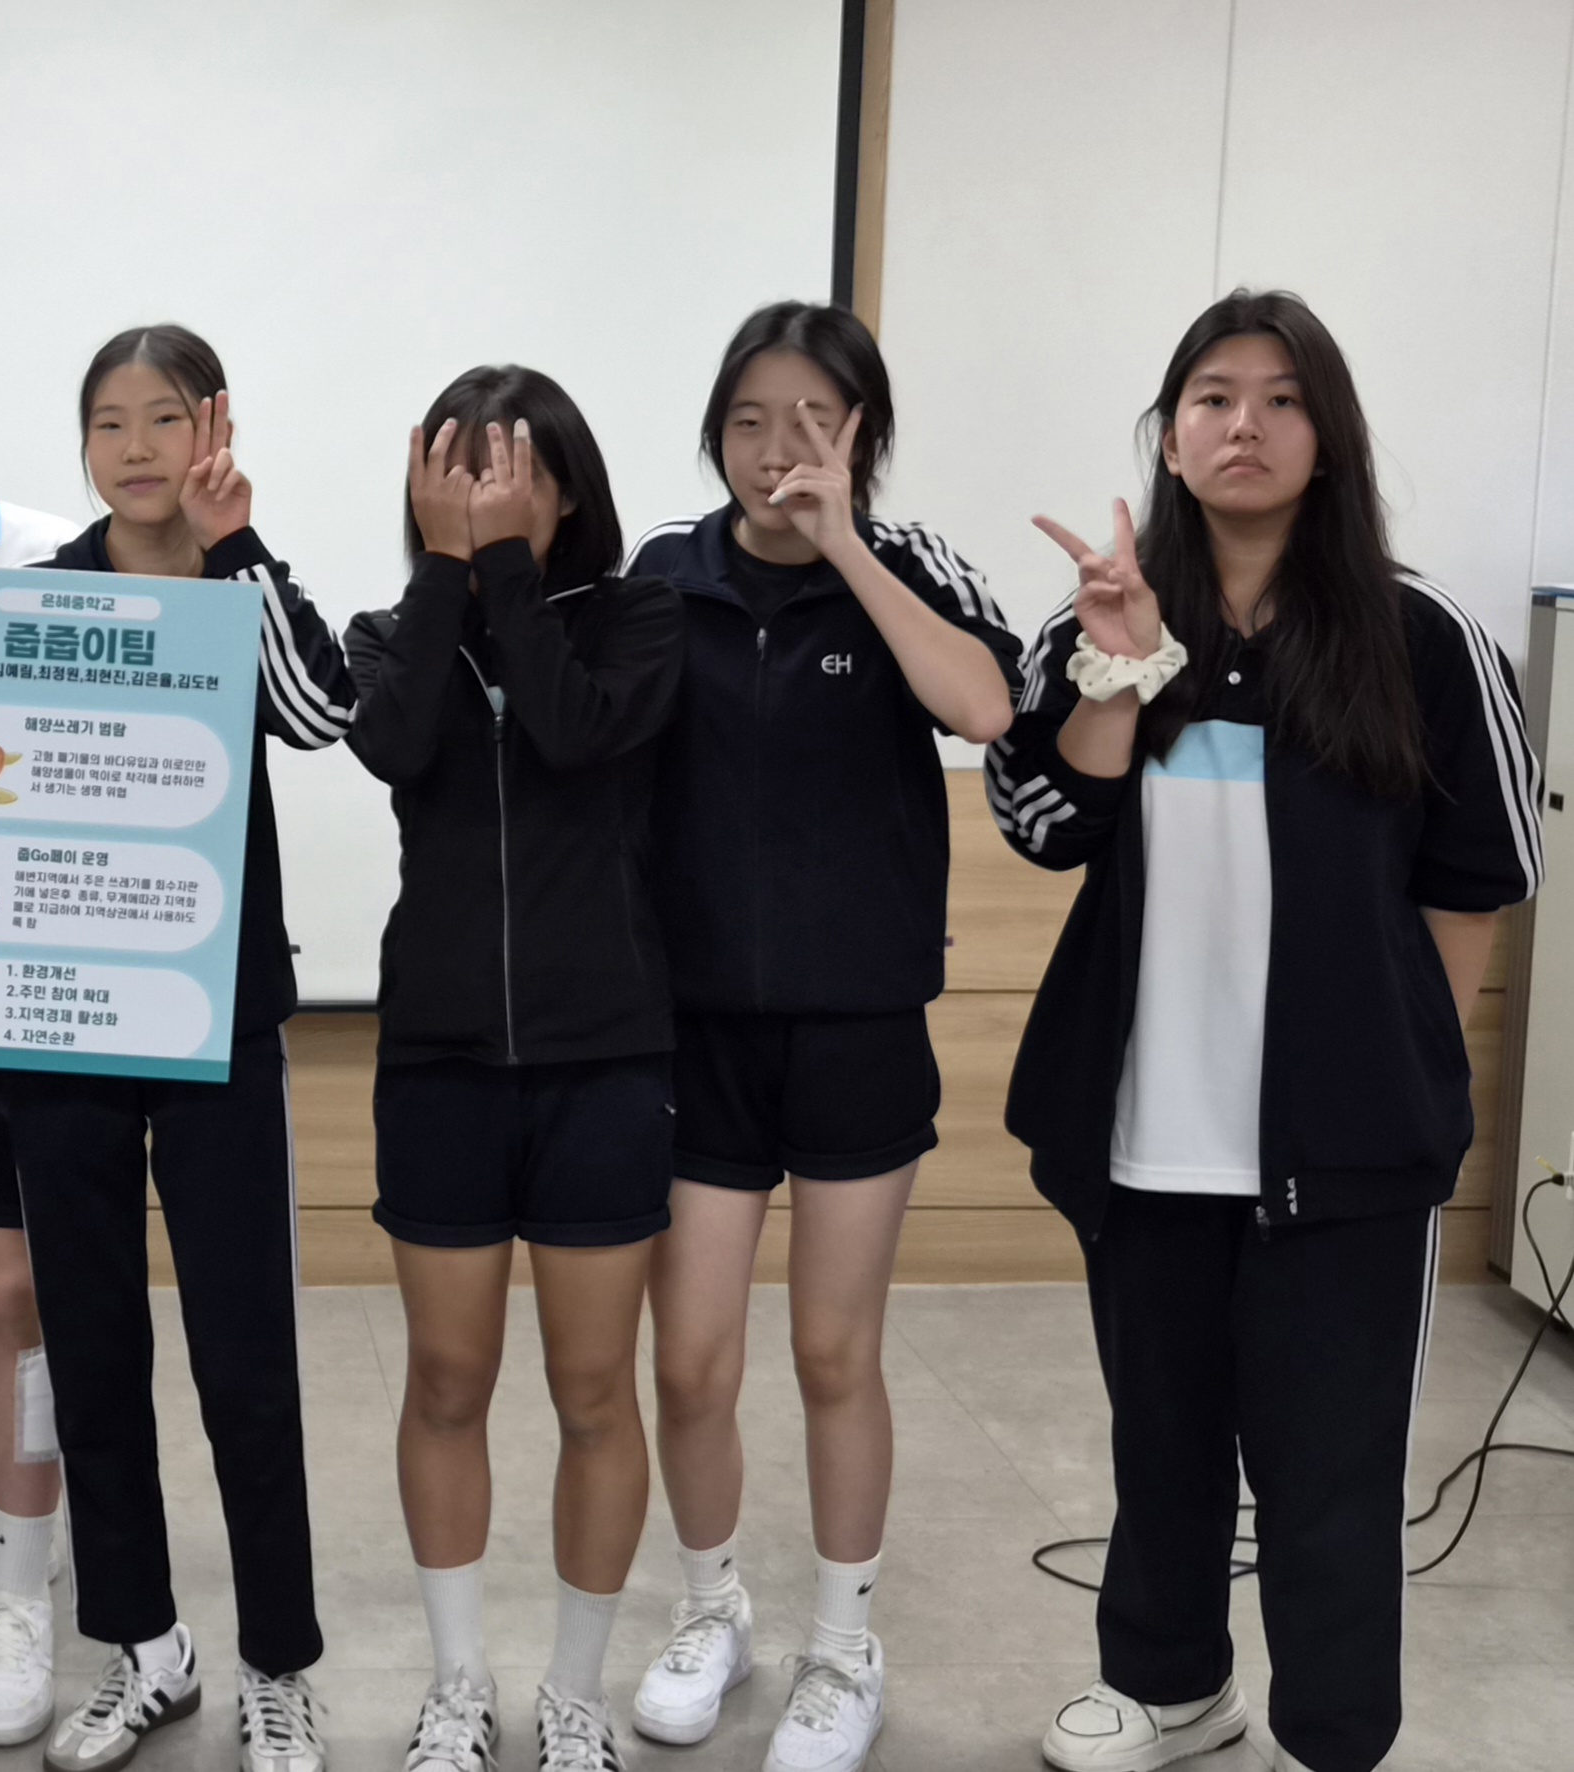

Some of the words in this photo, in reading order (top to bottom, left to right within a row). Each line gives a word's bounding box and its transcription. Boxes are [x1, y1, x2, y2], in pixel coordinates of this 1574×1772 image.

[40, 592, 116, 612] 은혜중학교
[821, 653, 852, 675] EH
[24, 716, 94, 735] 해양쓰레기
[98, 721, 127, 738] 범람
[104, 754, 159, 770] 바다유입과
[162, 757, 206, 773] 이로인한
[31, 765, 86, 781] 해양생물이
[89, 768, 122, 783] 먹이로
[125, 771, 158, 785] 착각해
[30, 781, 42, 794] 서
[44, 782, 77, 796] 생기는
[81, 784, 103, 798] 생명
[81, 850, 109, 867] 운영
[14, 870, 80, 886] 해변지역에서
[108, 876, 152, 891] 쓰레기를
[13, 885, 36, 898] 기에
[164, 895, 197, 909] 지역화
[38, 902, 81, 917] 지급하여
[152, 909, 197, 924] 사용하도
[6, 964, 19, 978] 1.
[22, 963, 77, 982] 환경개선
[51, 985, 79, 1003] 참여
[82, 988, 111, 1005] 확대
[77, 1010, 119, 1027] 활성화
[3, 1029, 17, 1042] 4.
[21, 1029, 77, 1047] 자연순환
